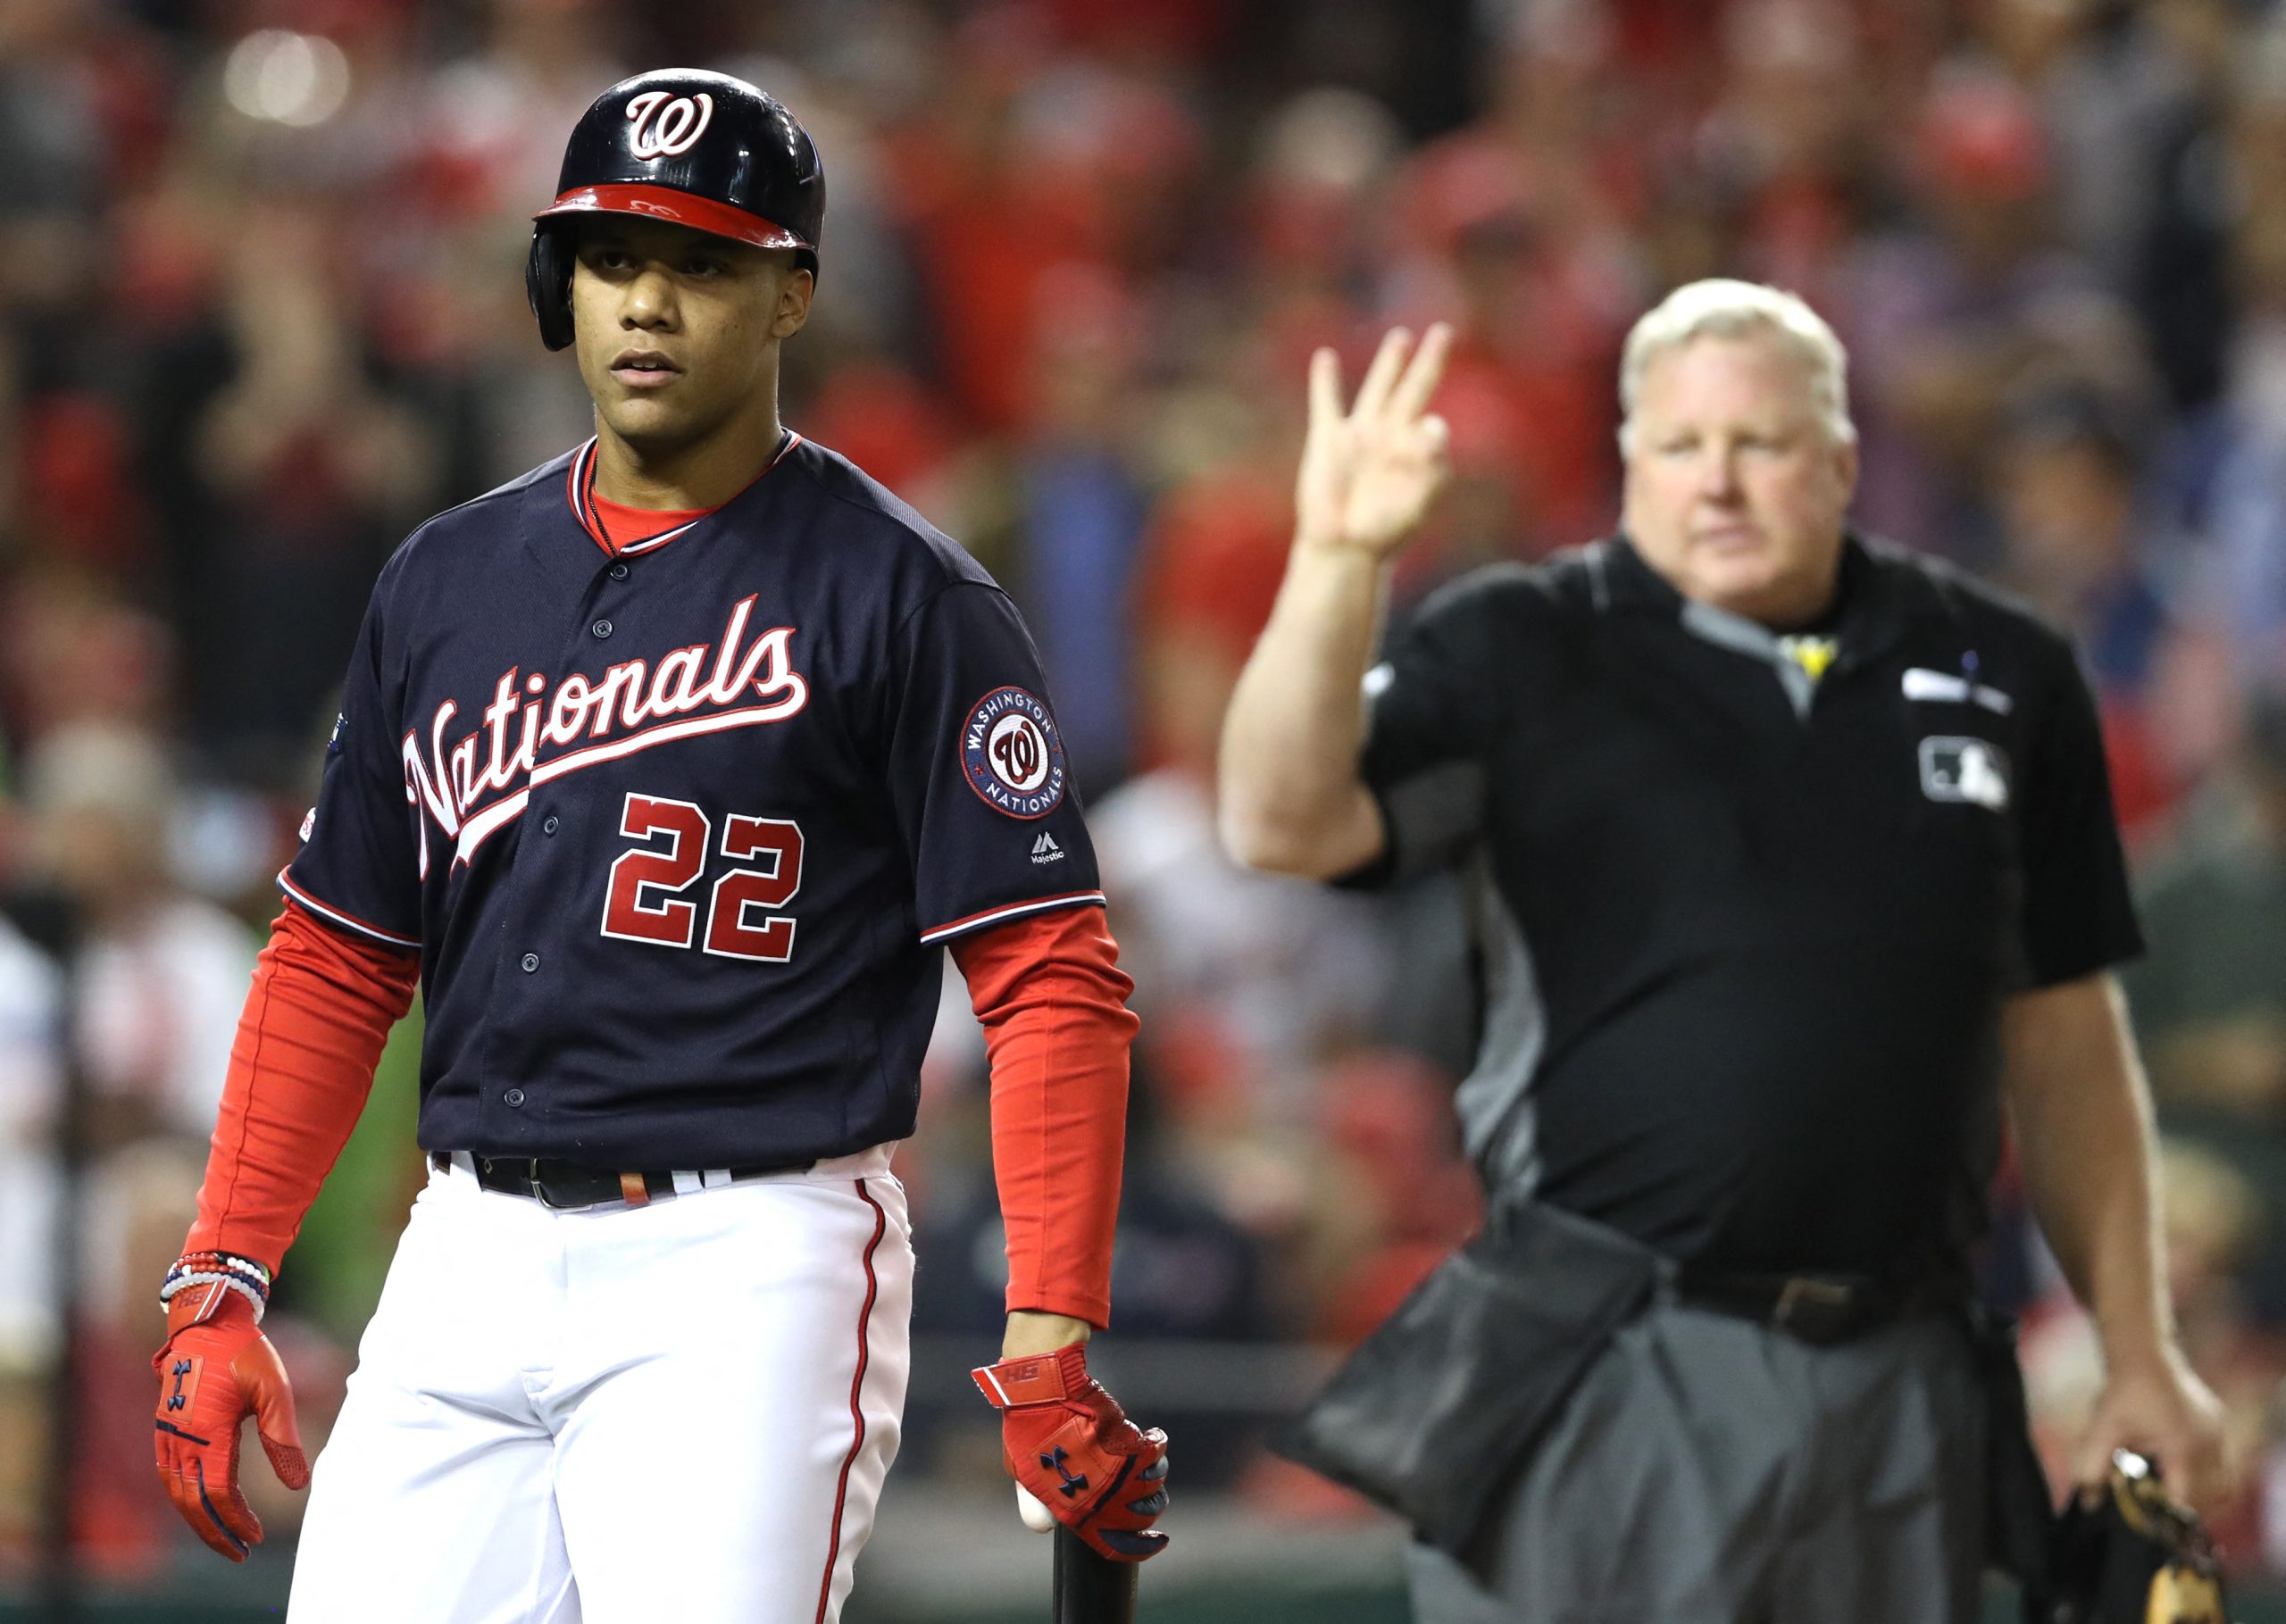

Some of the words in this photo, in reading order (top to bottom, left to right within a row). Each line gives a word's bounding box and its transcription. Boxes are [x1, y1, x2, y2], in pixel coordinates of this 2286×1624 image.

[403, 593, 809, 882] Nationals
[968, 691, 1052, 750] WASHINGTON
[986, 766, 1063, 813] NATIONALS
[601, 792, 805, 963] 22
[1030, 850, 1065, 865] Majestic
